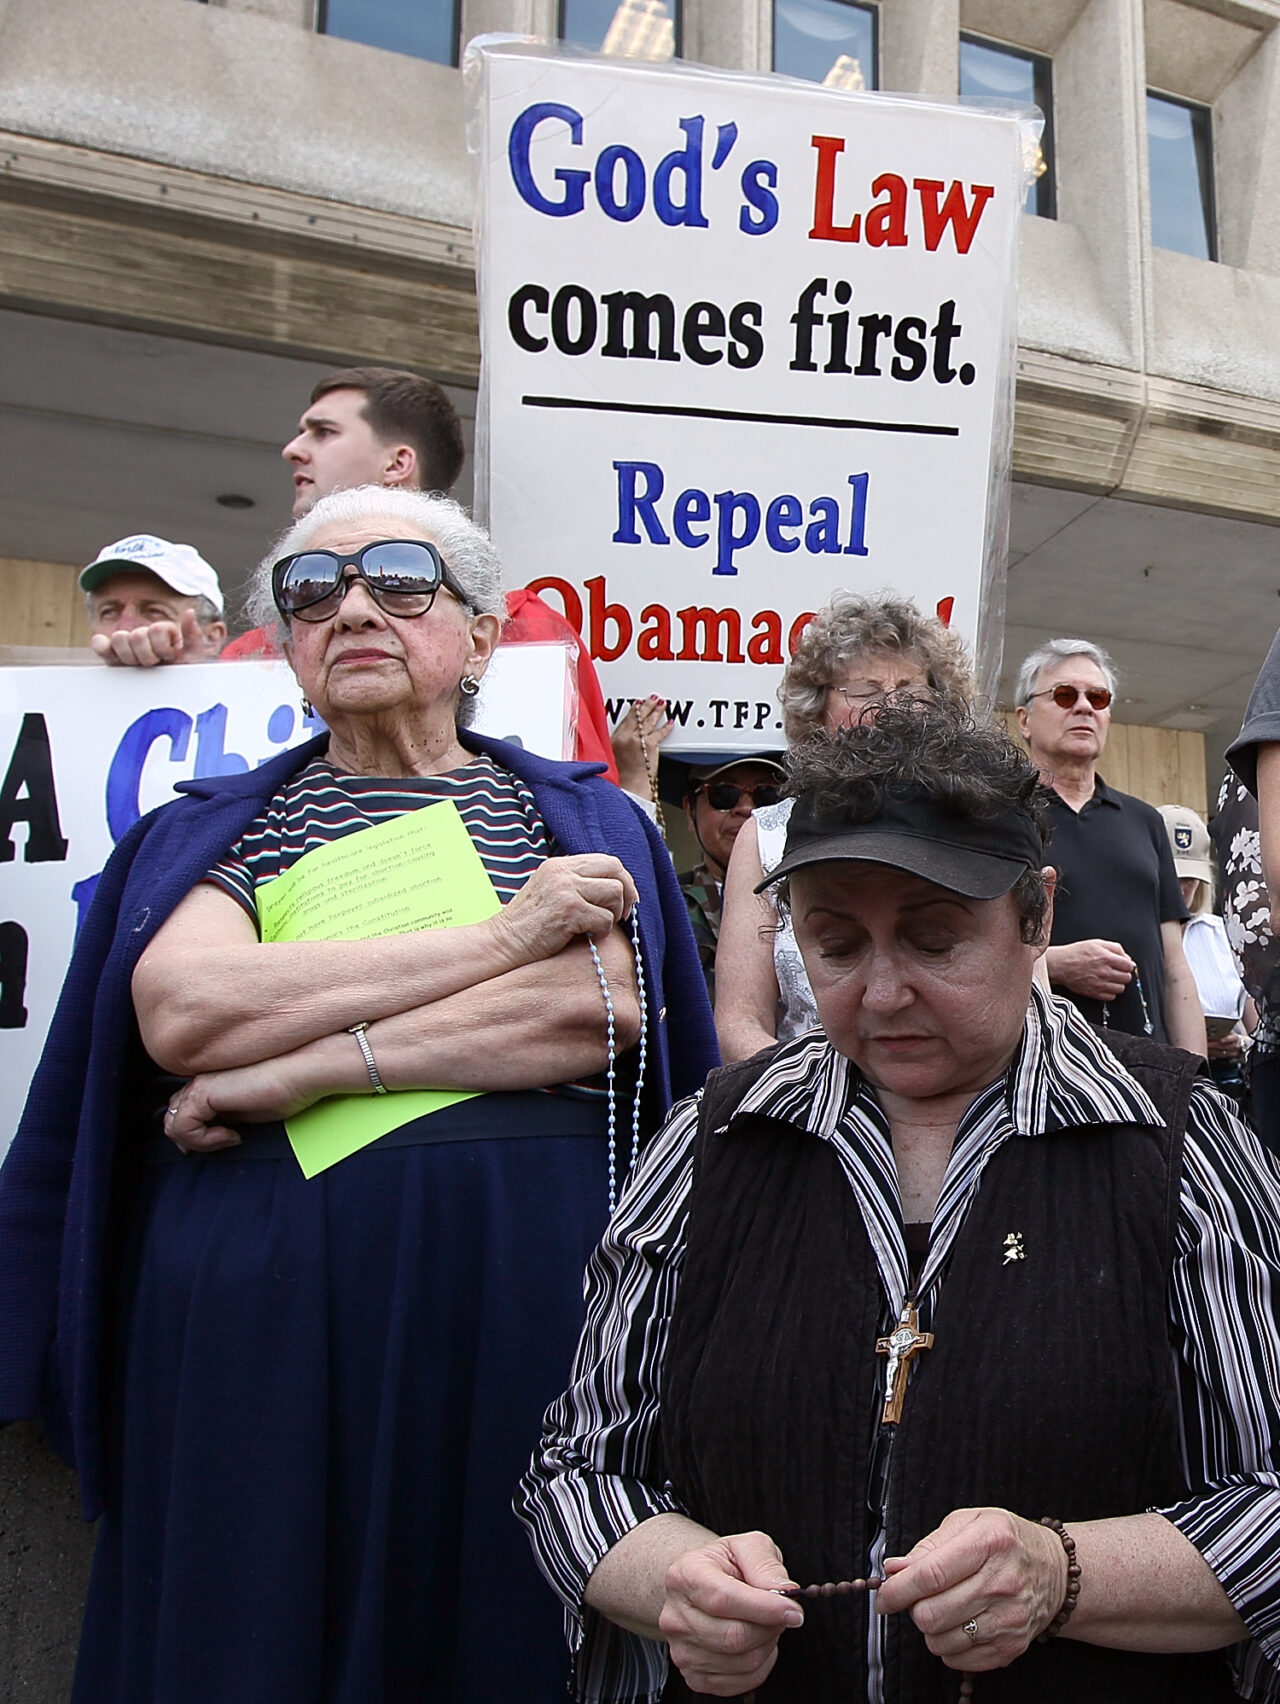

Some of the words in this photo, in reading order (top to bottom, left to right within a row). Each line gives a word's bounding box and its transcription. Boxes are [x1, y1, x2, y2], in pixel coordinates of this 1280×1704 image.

[507, 101, 779, 236] God's
[808, 135, 995, 254] Law
[507, 283, 763, 370] comes
[788, 278, 976, 386] first.
[612, 460, 870, 576] Repeal
